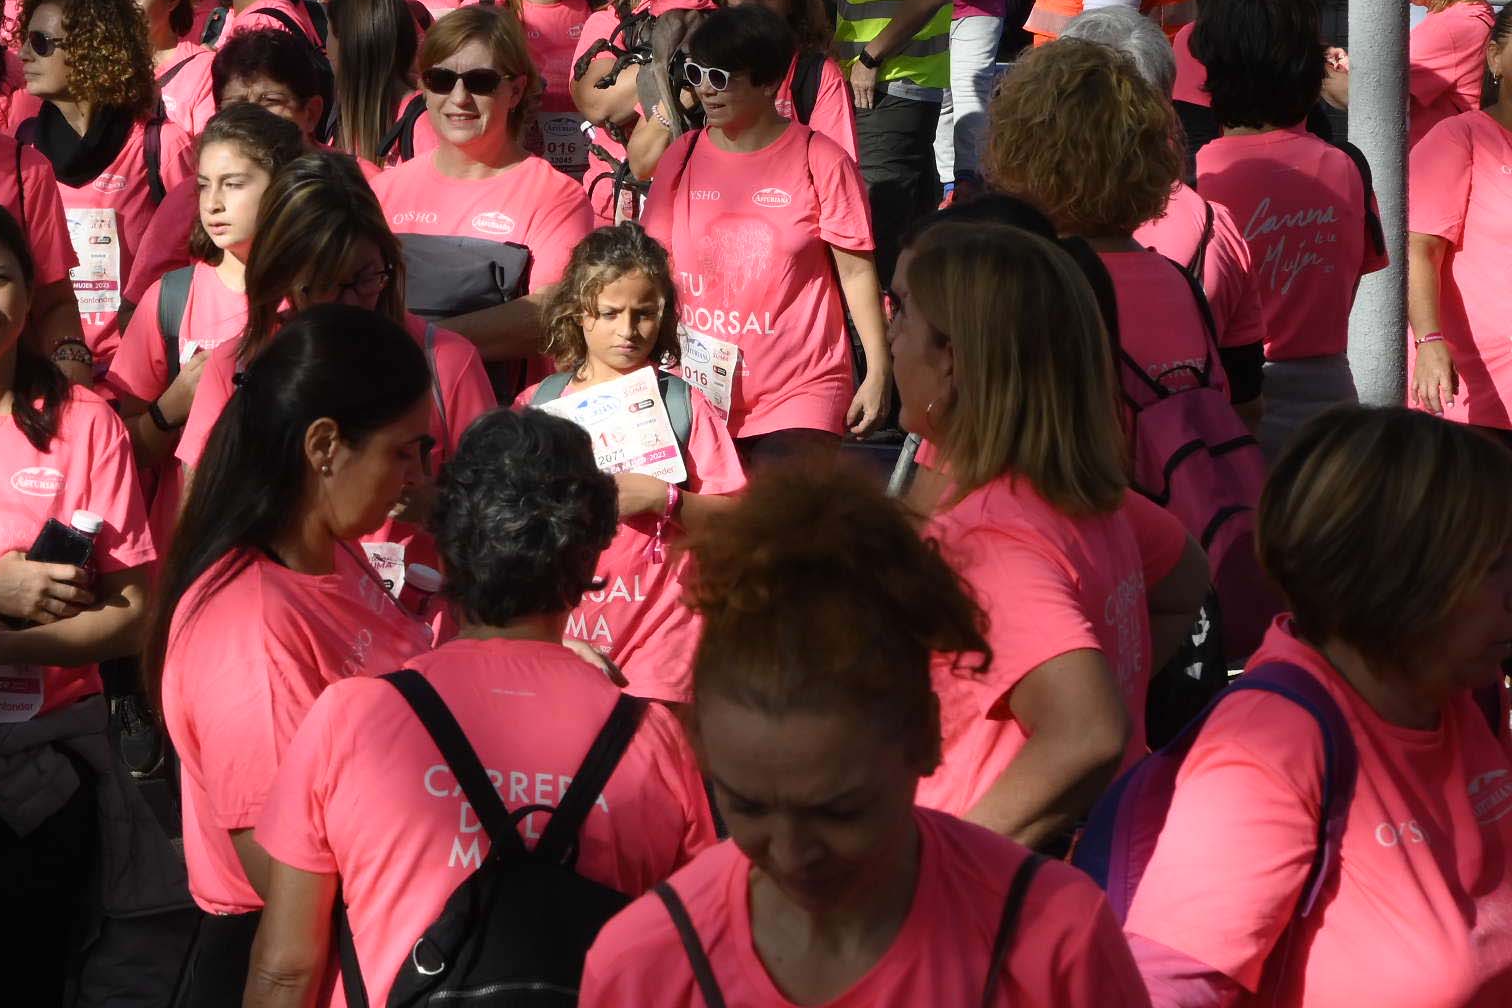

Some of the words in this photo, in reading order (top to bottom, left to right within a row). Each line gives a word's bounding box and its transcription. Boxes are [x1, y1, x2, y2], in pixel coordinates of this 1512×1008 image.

[547, 141, 577, 154] 016
[690, 190, 720, 201] YSHO
[680, 272, 706, 297] TU
[683, 303, 776, 336] DORSAL
[684, 364, 709, 386] 016
[564, 613, 613, 643] MA
